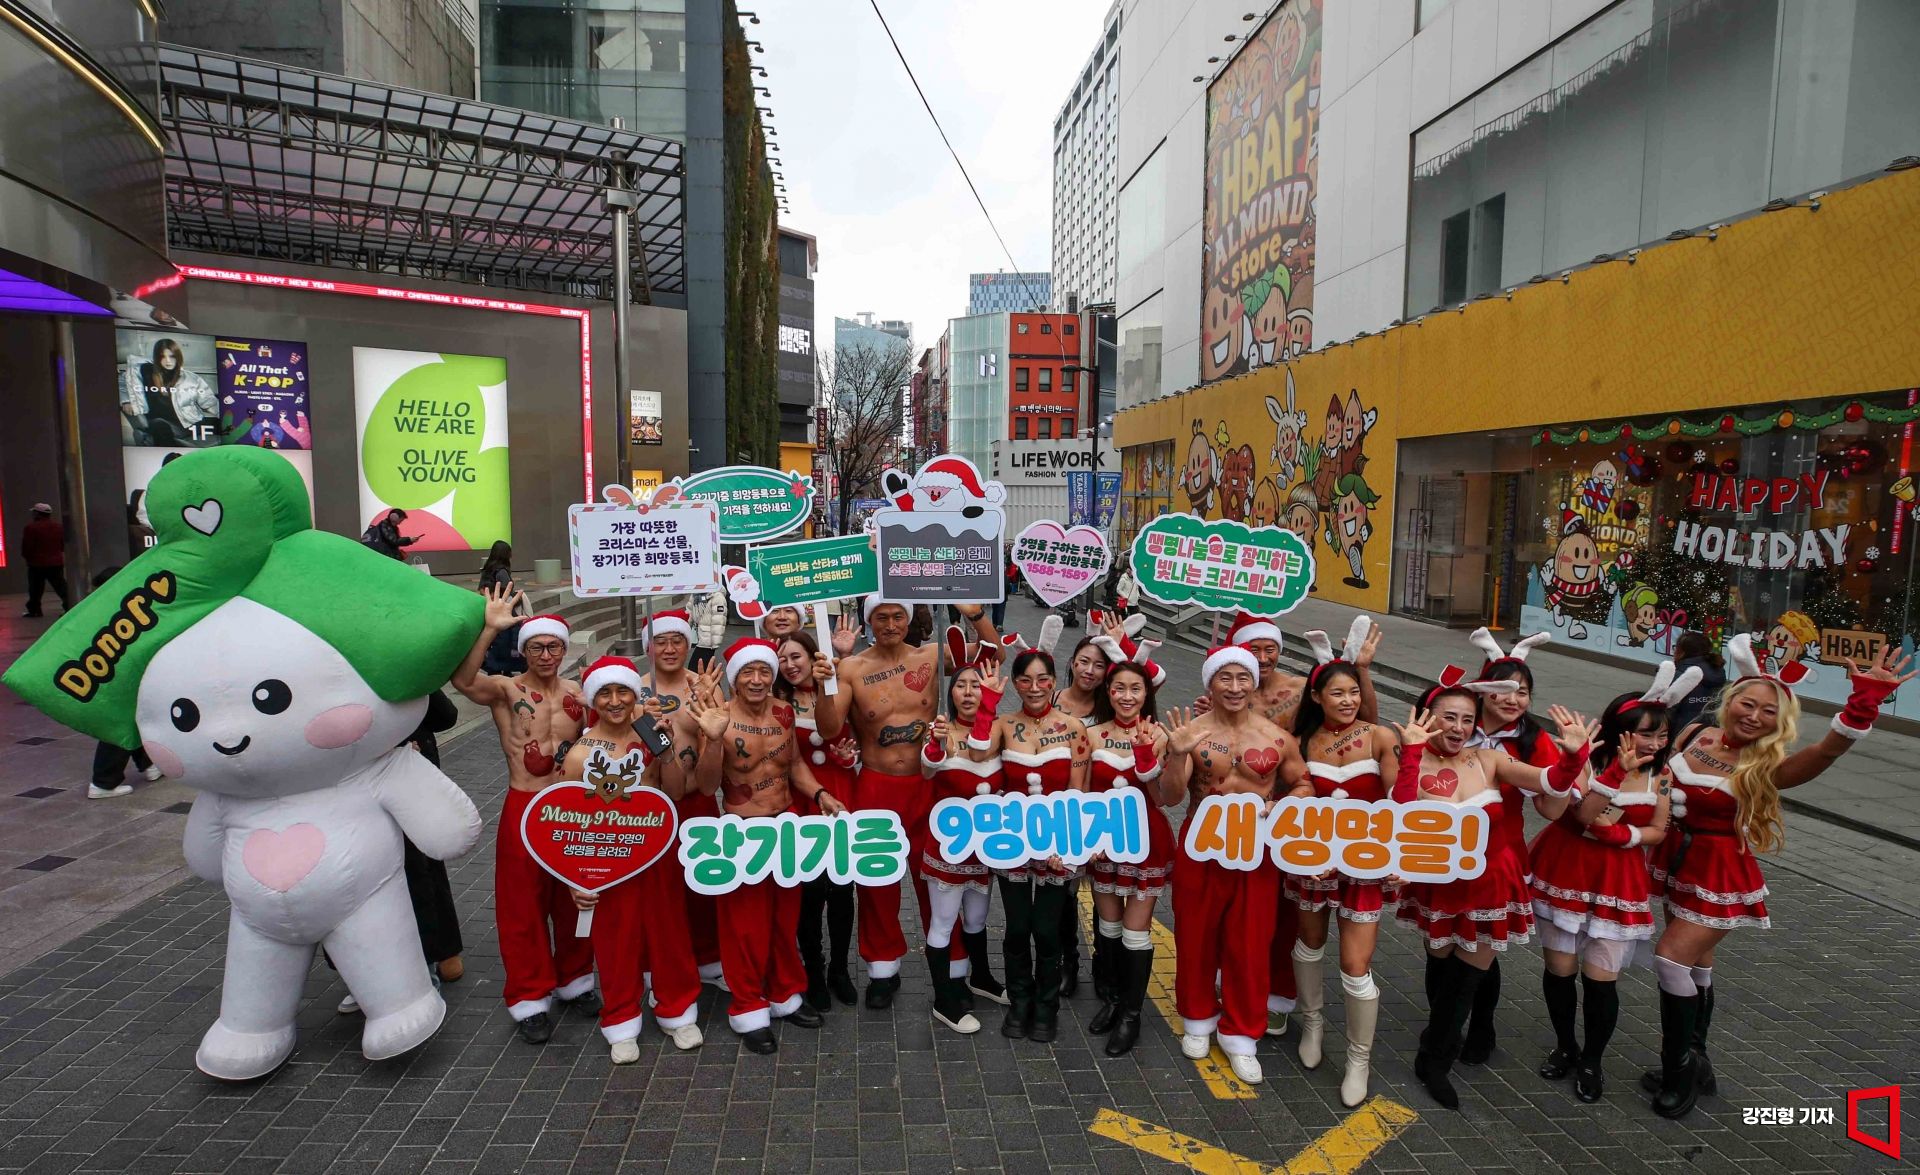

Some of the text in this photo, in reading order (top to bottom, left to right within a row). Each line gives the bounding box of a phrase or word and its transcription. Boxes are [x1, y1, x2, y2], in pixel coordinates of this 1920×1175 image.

[1221, 74, 1307, 222] HBAF
[1213, 181, 1310, 276] ALMOND
[1230, 231, 1283, 290] store
[256, 275, 285, 286] HAPPY
[288, 279, 308, 287] NEW
[313, 281, 335, 290] YEAR
[462, 297, 485, 307] HAPPY
[239, 364, 289, 375] All That
[133, 385, 206, 395] GIORDANO
[233, 374, 294, 389] K-POP
[398, 399, 470, 418] HELLO
[188, 425, 214, 441] 1F
[394, 416, 475, 435] WE ARE
[403, 449, 468, 465] OLIVE
[398, 466, 476, 483] YOUNG
[732, 487, 787, 500] 희망등록으로
[1691, 469, 1829, 515] HAPPY
[723, 501, 792, 516] 기적을 전하세요!
[611, 520, 677, 535] 가장 따뜻한
[599, 535, 692, 551] 크리스마스 선물,
[1020, 537, 1048, 552] 9명을
[1049, 540, 1081, 556] 구하는
[1673, 520, 1852, 570] HOLIDAY
[592, 550, 699, 568] 장기기증 희망등록!
[888, 546, 992, 561] 생명나눔 산타와 함께
[1016, 549, 1105, 570] 장기기증 희망등록!
[1147, 532, 1302, 575] 생명나눔으로 장식하는
[770, 553, 863, 576] 생명나눔 산타와 함께
[888, 562, 991, 577] 소중한 생명을 살려요!
[1026, 562, 1089, 581] 1588-1589
[812, 569, 853, 584] 선물해요!
[1156, 558, 1284, 596] 빛나는 크리스마스!
[58, 592, 152, 699] Donor
[1826, 634, 1880, 658] HBAF
[1039, 730, 1078, 747] Donor
[1104, 738, 1132, 750] Don
[1208, 741, 1229, 755] 1589
[540, 805, 666, 828] Merry 9 Parade!
[936, 795, 1141, 860] 9명에게
[552, 829, 645, 845] 장기기증으로 9명의
[1194, 802, 1480, 875] 새 생명을!
[563, 843, 632, 858] 생명을 살려요!
[686, 817, 902, 886] 장기기증
